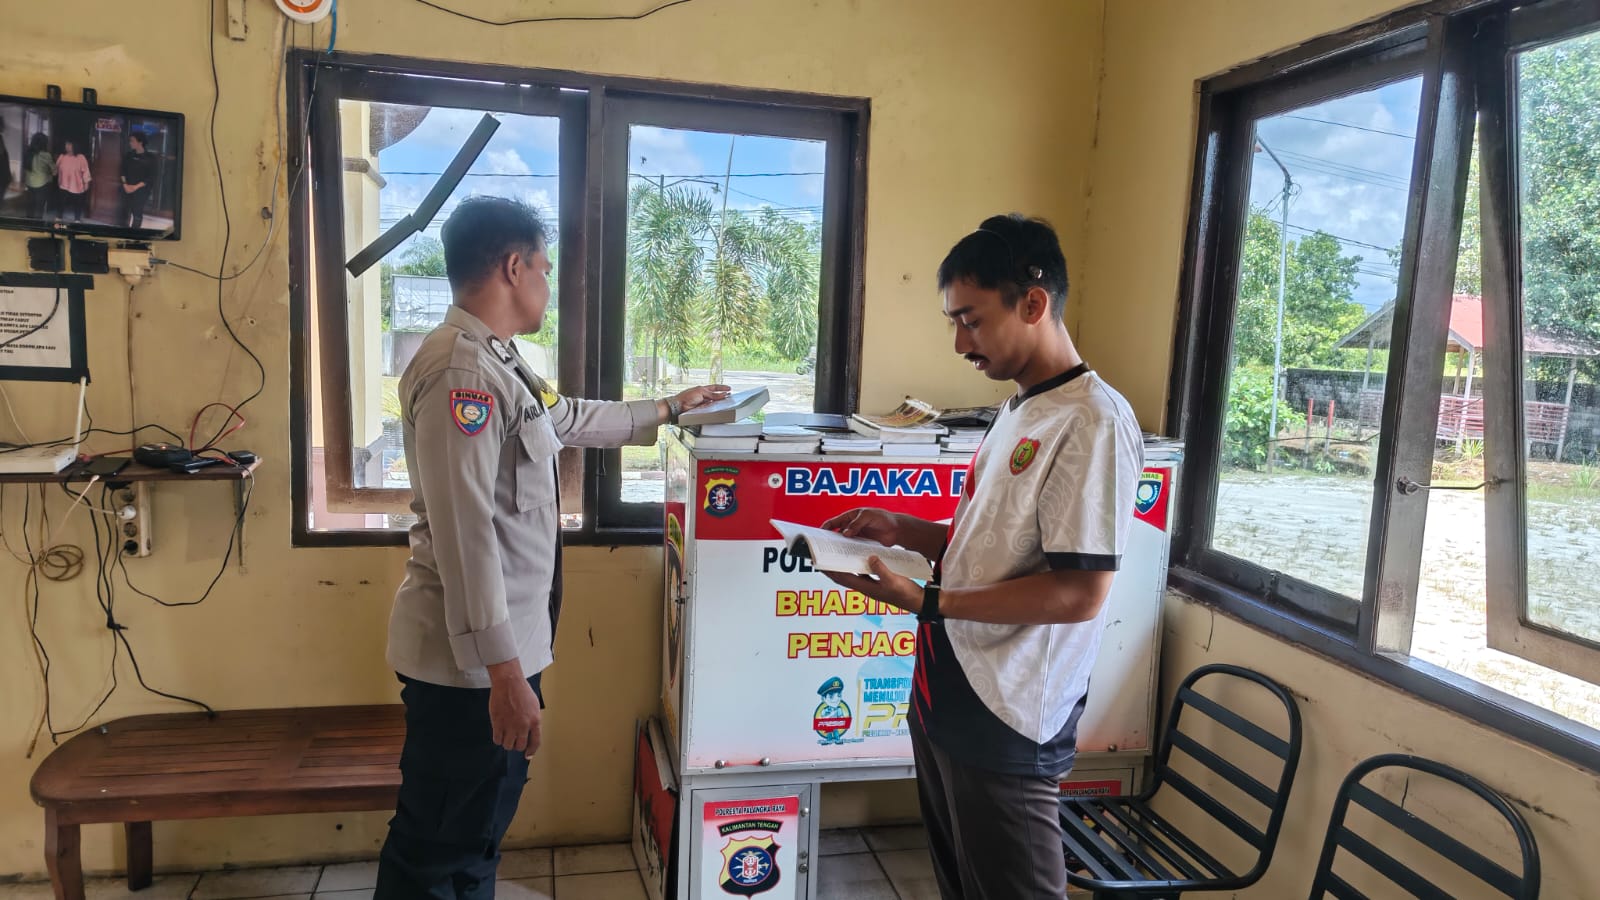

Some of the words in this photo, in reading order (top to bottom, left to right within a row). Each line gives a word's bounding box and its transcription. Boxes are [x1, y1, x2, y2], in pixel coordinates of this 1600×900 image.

[785, 467, 942, 496] BAJAKA
[721, 822, 756, 832] KALIMANTAN
[757, 821, 779, 829] TENGAH
